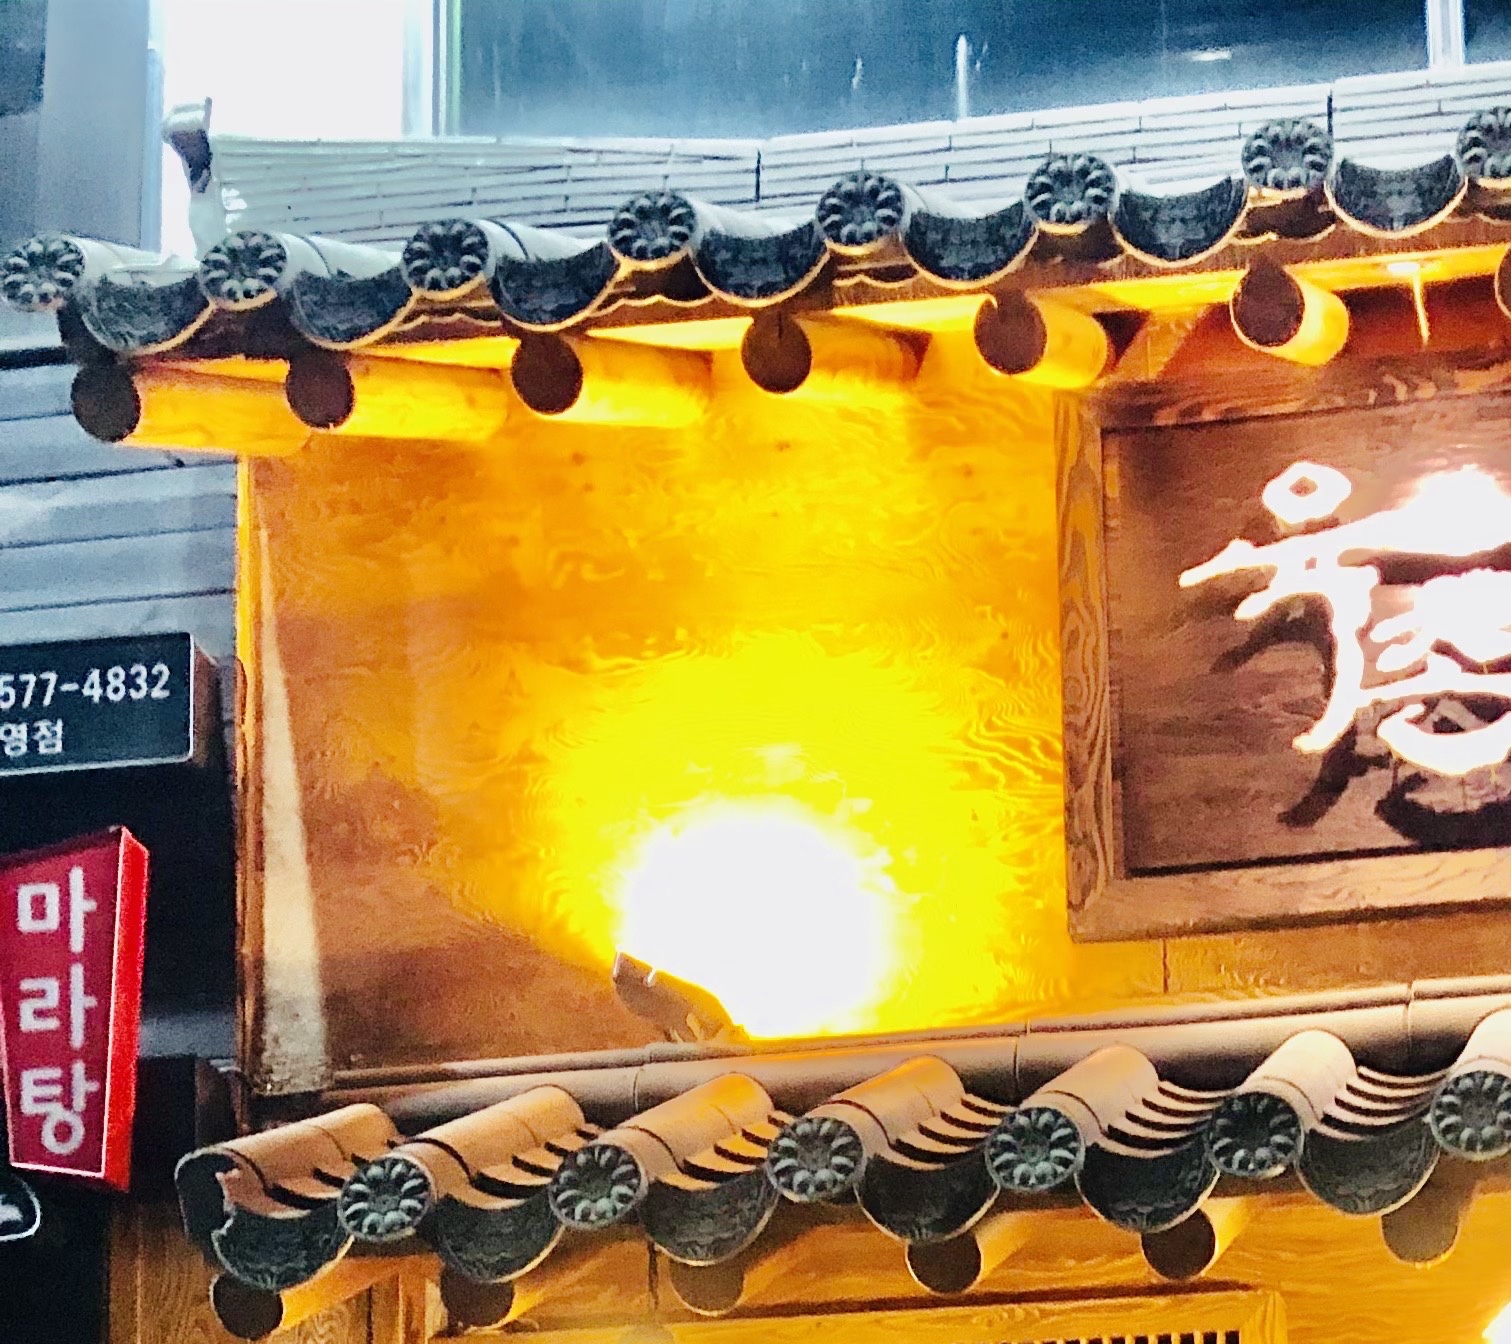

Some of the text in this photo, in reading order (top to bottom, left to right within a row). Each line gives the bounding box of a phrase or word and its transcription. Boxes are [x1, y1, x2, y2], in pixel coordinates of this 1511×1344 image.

[0, 661, 170, 708] 577-4832
[0, 718, 63, 757] 영점
[16, 865, 99, 1155] 마라탕
